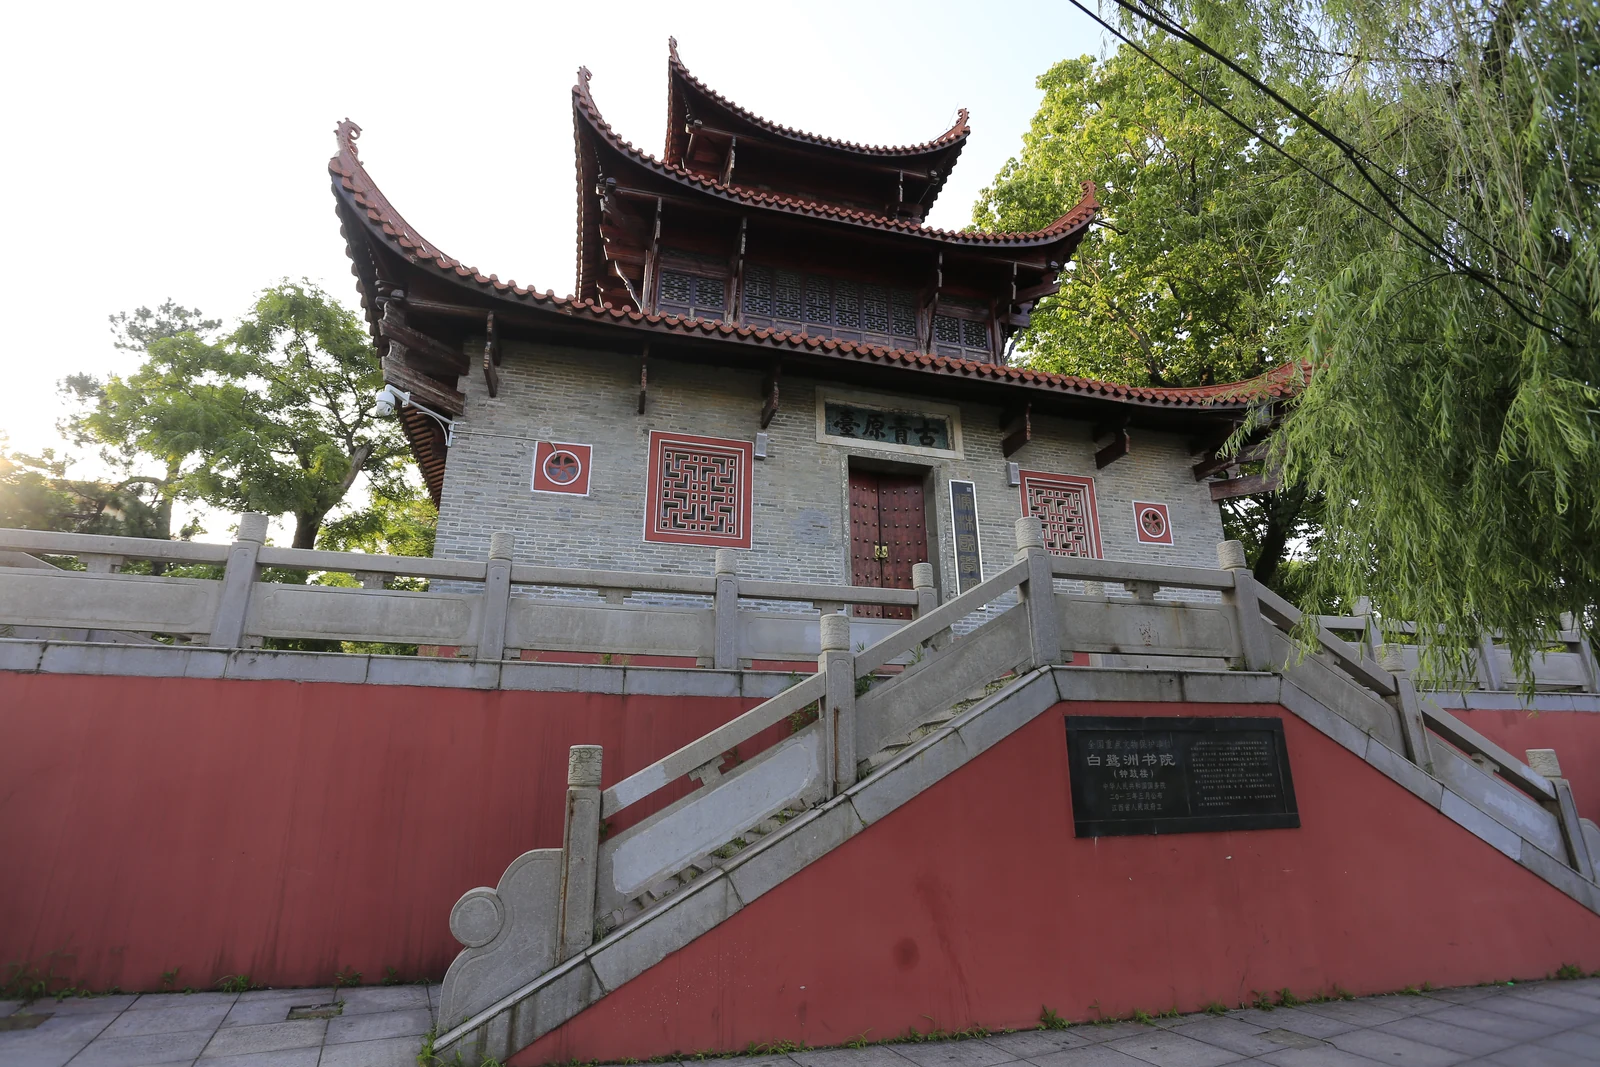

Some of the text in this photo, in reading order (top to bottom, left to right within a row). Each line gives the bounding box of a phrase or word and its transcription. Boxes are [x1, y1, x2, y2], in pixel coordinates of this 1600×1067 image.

[1086, 752, 1176, 768] 白鹭洲书院
[1102, 781, 1167, 791] 中华人民共和国国务院
